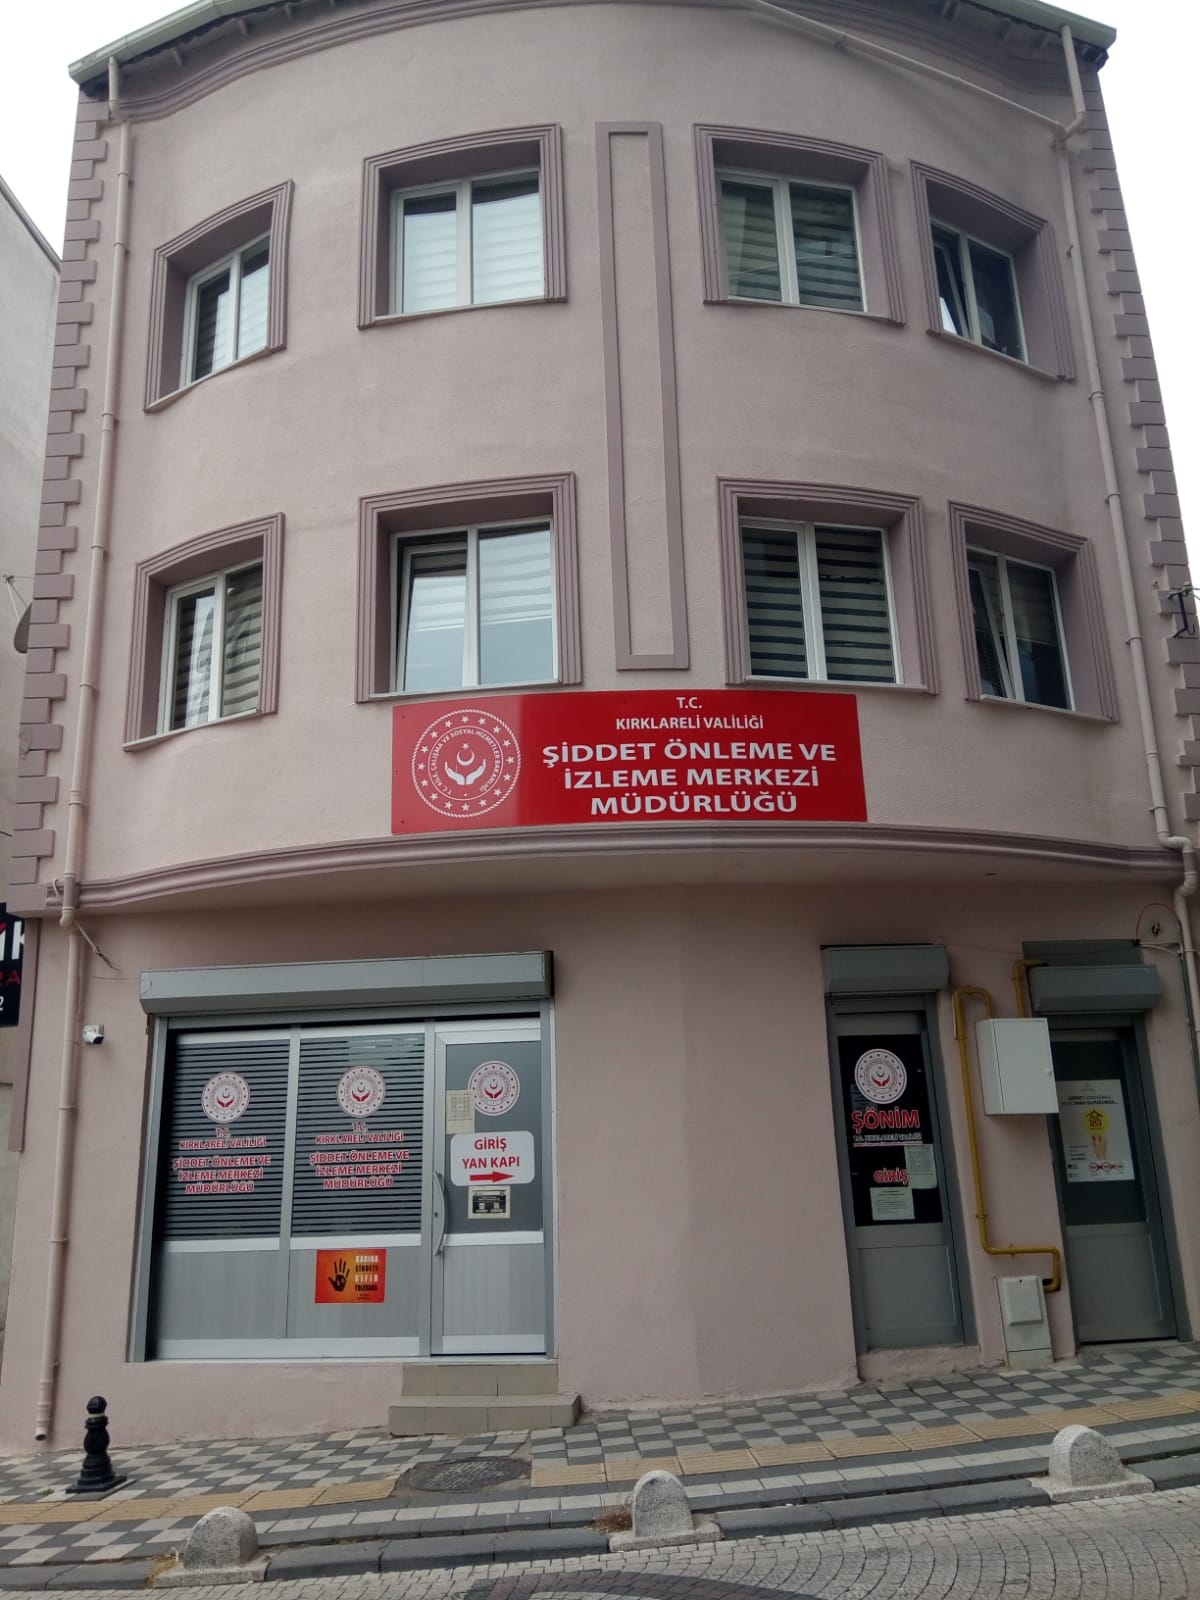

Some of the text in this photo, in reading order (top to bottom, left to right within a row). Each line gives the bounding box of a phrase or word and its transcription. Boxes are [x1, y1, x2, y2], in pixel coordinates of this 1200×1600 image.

[676, 696, 702, 709] T.C.
[616, 714, 764, 730] KIRKLARELİ VALİLİĞİ
[543, 738, 837, 768] ŞİDDET ÖNLEME VE
[564, 766, 819, 789] İZLEME MERKEZİ
[591, 791, 797, 815] MÜDÜRLÜĞÜ
[851, 1106, 920, 1134] ŞÖNİM
[474, 1136, 507, 1152] GİRİŞ
[257, 1155, 271, 1165] VE
[395, 1150, 409, 1160] VE
[462, 1156, 520, 1169] YAN KAPI
[873, 1167, 909, 1185] GİRİŞ
